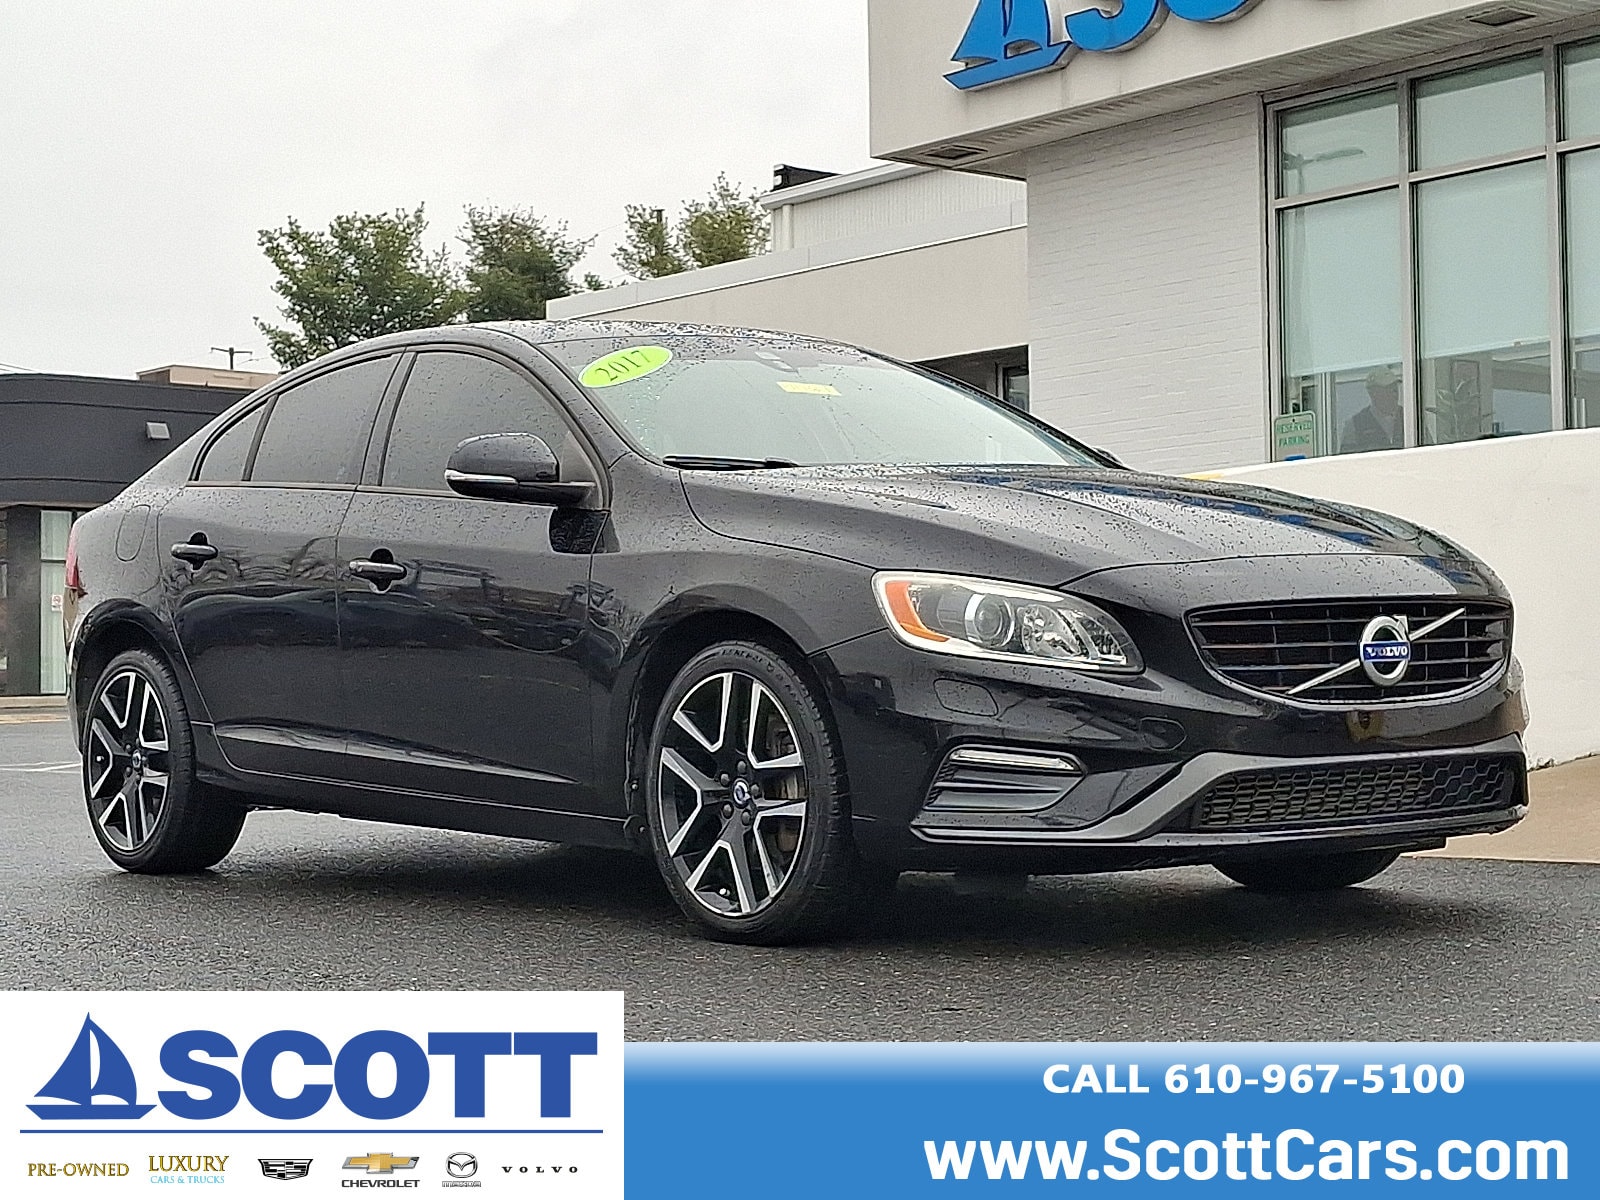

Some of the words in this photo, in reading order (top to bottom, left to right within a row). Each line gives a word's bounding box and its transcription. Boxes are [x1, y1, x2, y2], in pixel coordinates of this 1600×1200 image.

[595, 350, 650, 381] 2017
[1278, 435, 1310, 447] PARKING
[1365, 646, 1408, 656] VOLVO
